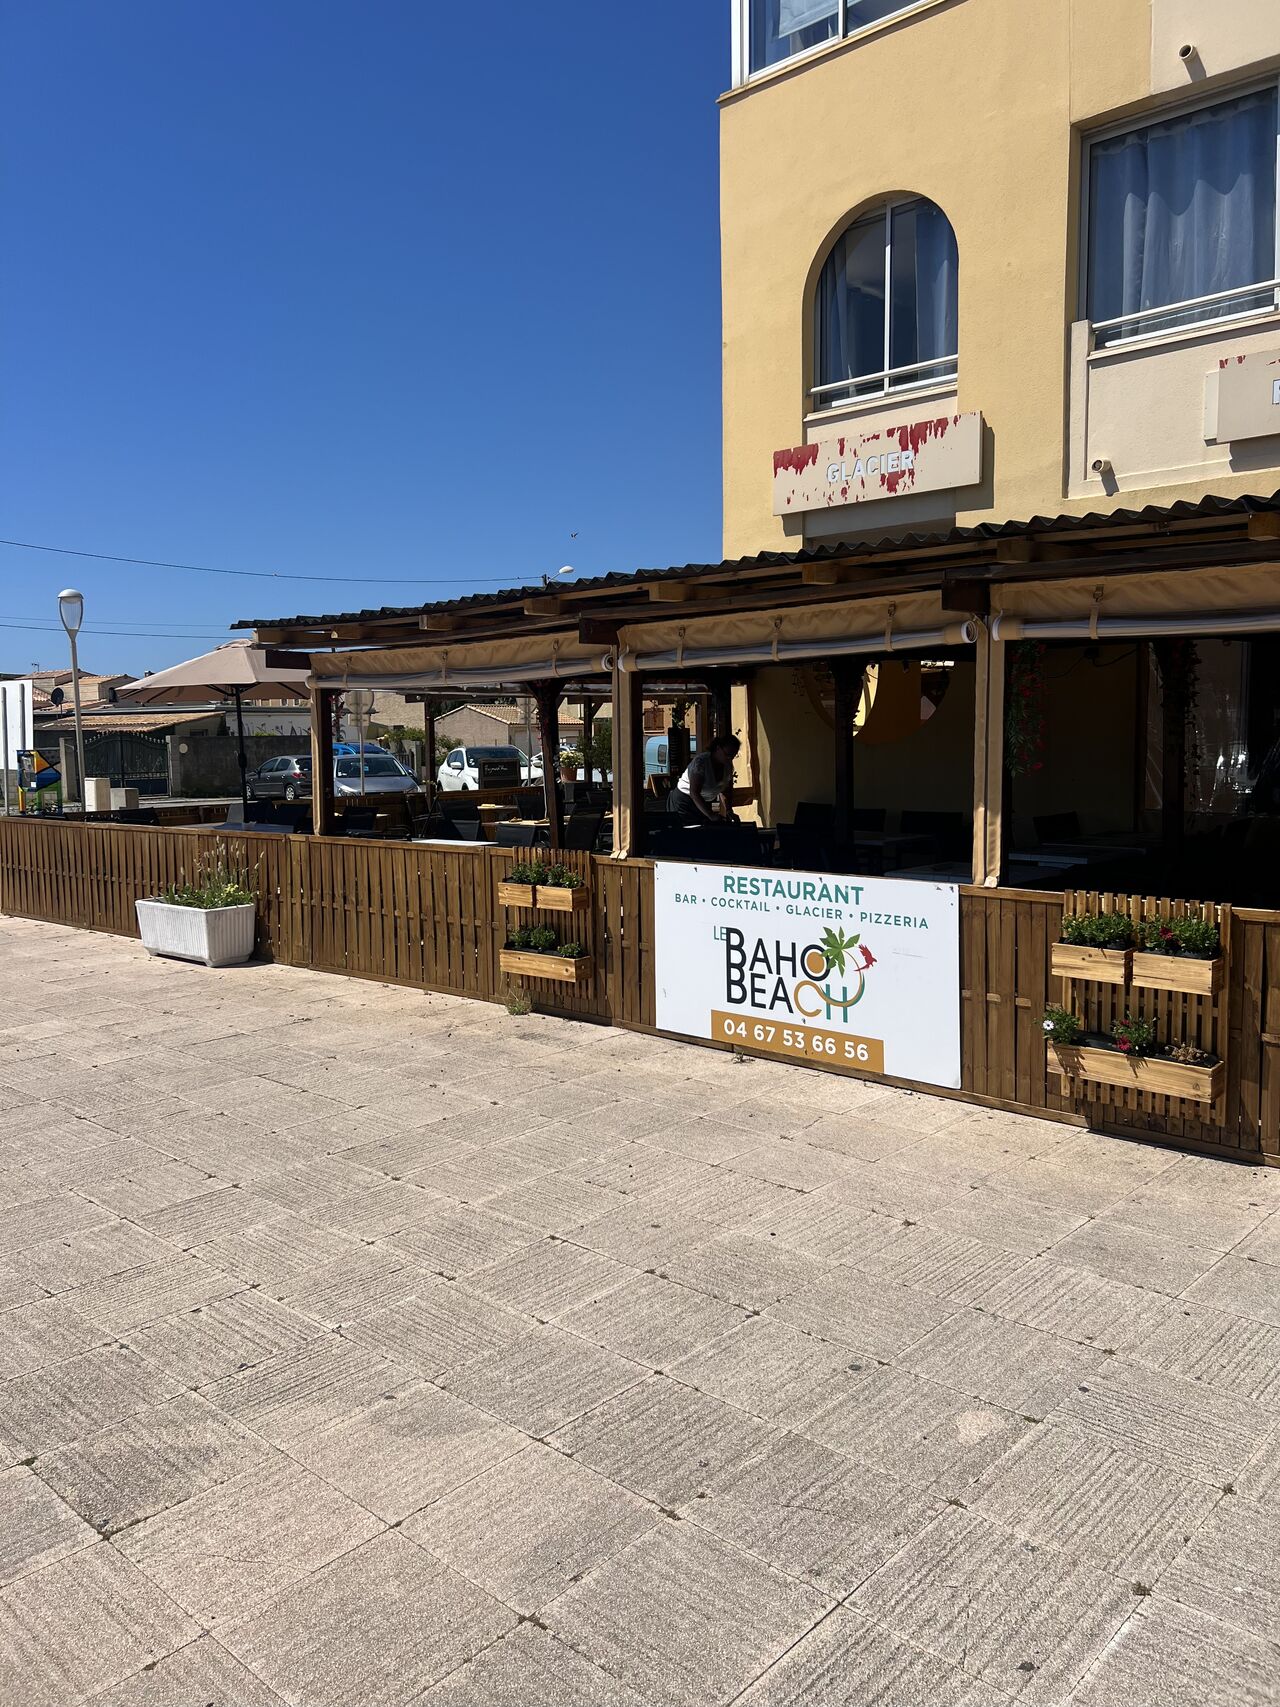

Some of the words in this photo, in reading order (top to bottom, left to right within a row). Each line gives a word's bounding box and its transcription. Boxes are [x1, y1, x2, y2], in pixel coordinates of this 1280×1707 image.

[826, 449, 915, 483] GLACIER
[723, 875, 864, 906] RESTAURANT
[675, 893, 697, 905] BAR
[711, 897, 771, 913] COCKTAIL
[786, 905, 843, 920] GLACIER
[860, 911, 929, 930] PIZZERIA
[713, 925, 728, 941] LE
[725, 927, 831, 982] BAHO
[726, 967, 850, 1024] BEACH
[723, 1019, 748, 1038] 04
[753, 1024, 775, 1043] 67
[783, 1029, 805, 1050] 53
[812, 1034, 837, 1055] 66
[844, 1040, 869, 1061] 56
